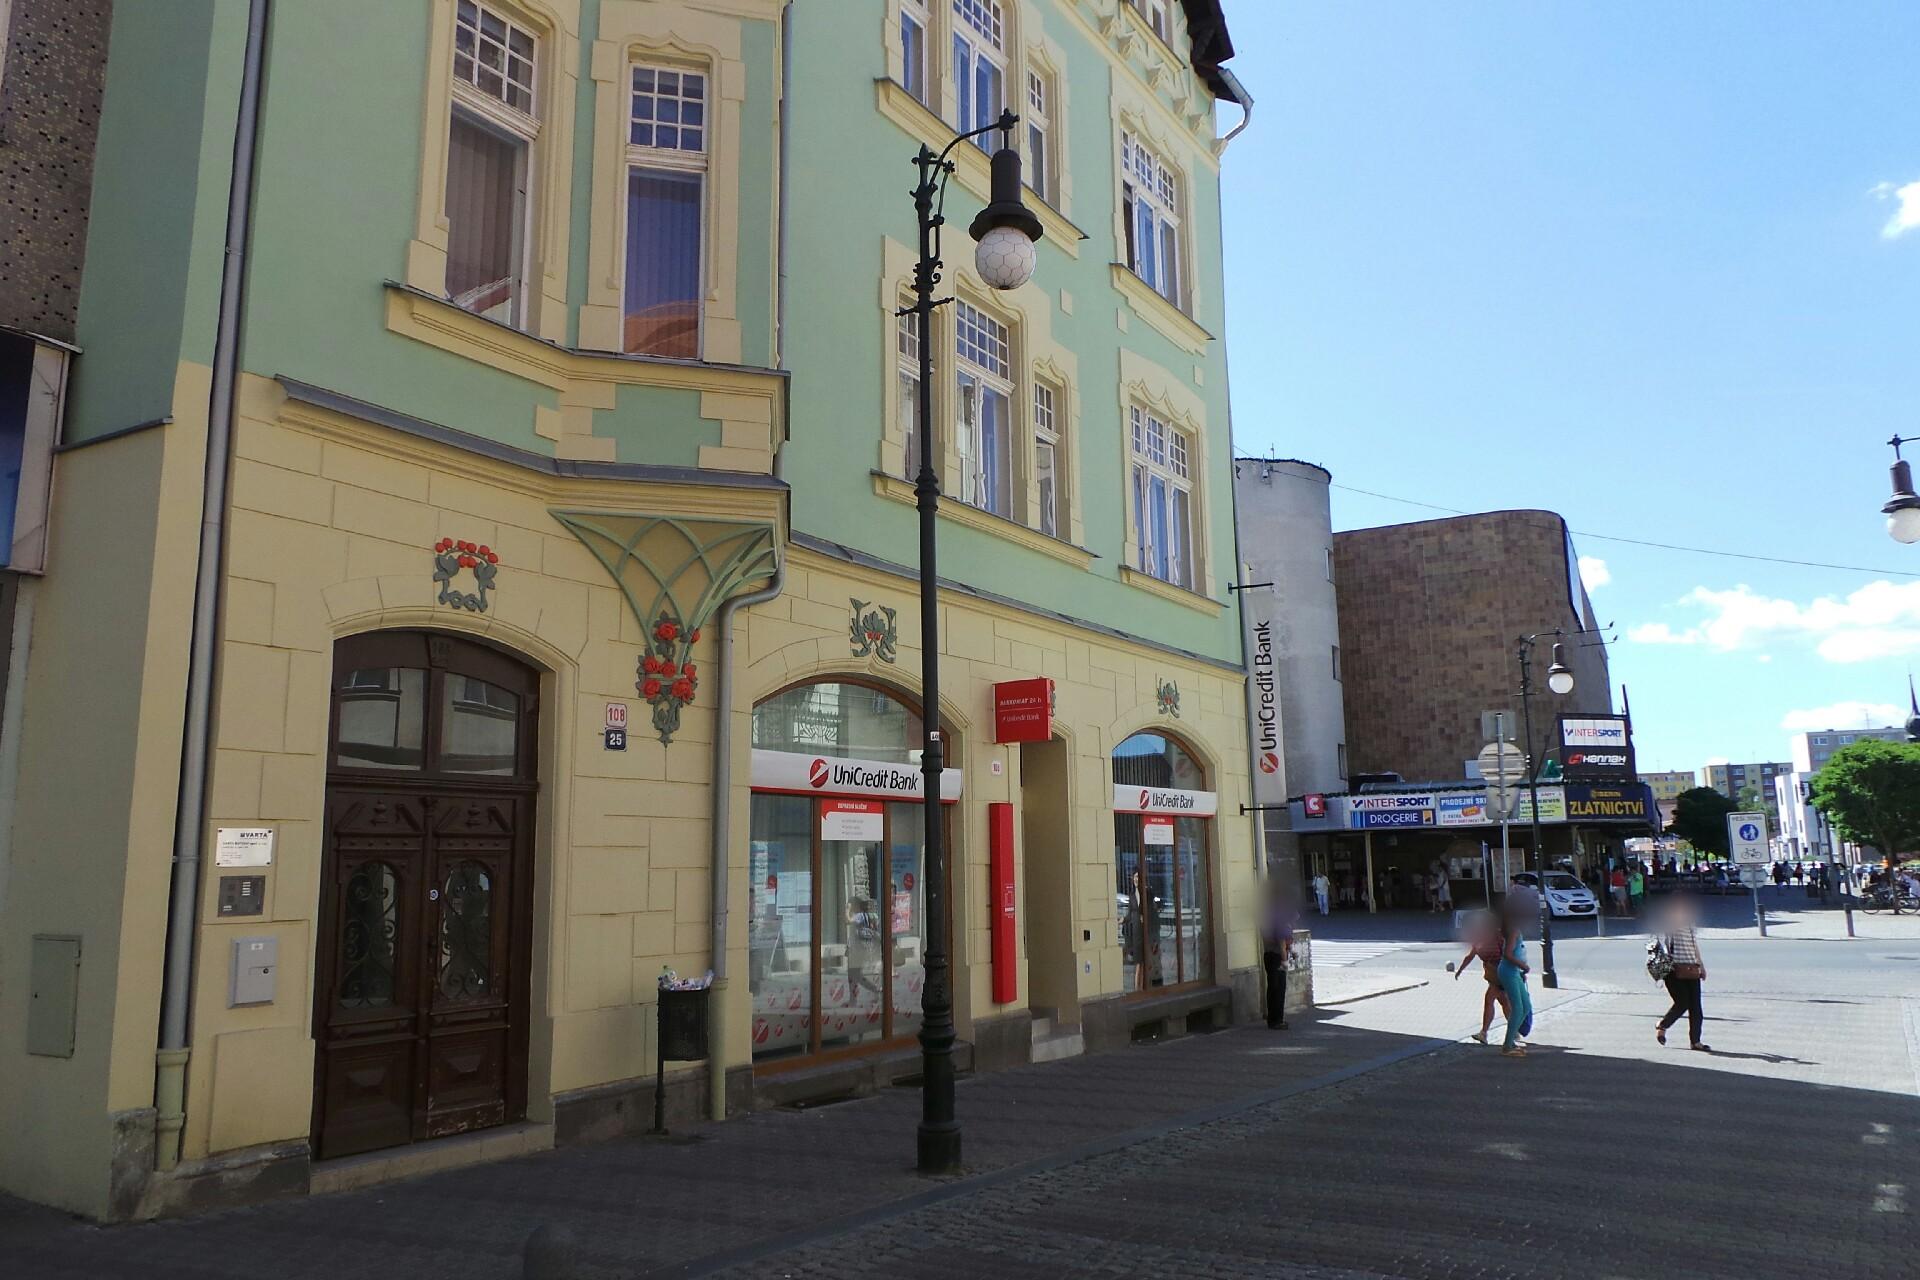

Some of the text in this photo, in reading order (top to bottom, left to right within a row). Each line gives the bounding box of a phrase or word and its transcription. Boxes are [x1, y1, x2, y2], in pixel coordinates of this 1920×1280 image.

[1253, 620, 1277, 751] UniCredit Bank
[608, 708, 625, 722] 108
[610, 733, 622, 746] 25
[1575, 728, 1623, 737] INTERSPORT
[833, 765, 919, 791] UniCredit Bank
[1152, 793, 1195, 809] UniCredit Bank
[1363, 797, 1431, 808] INTERSPORT
[1569, 798, 1645, 815] ZLATNICTVÍ
[1369, 812, 1419, 824] DROGERIE
